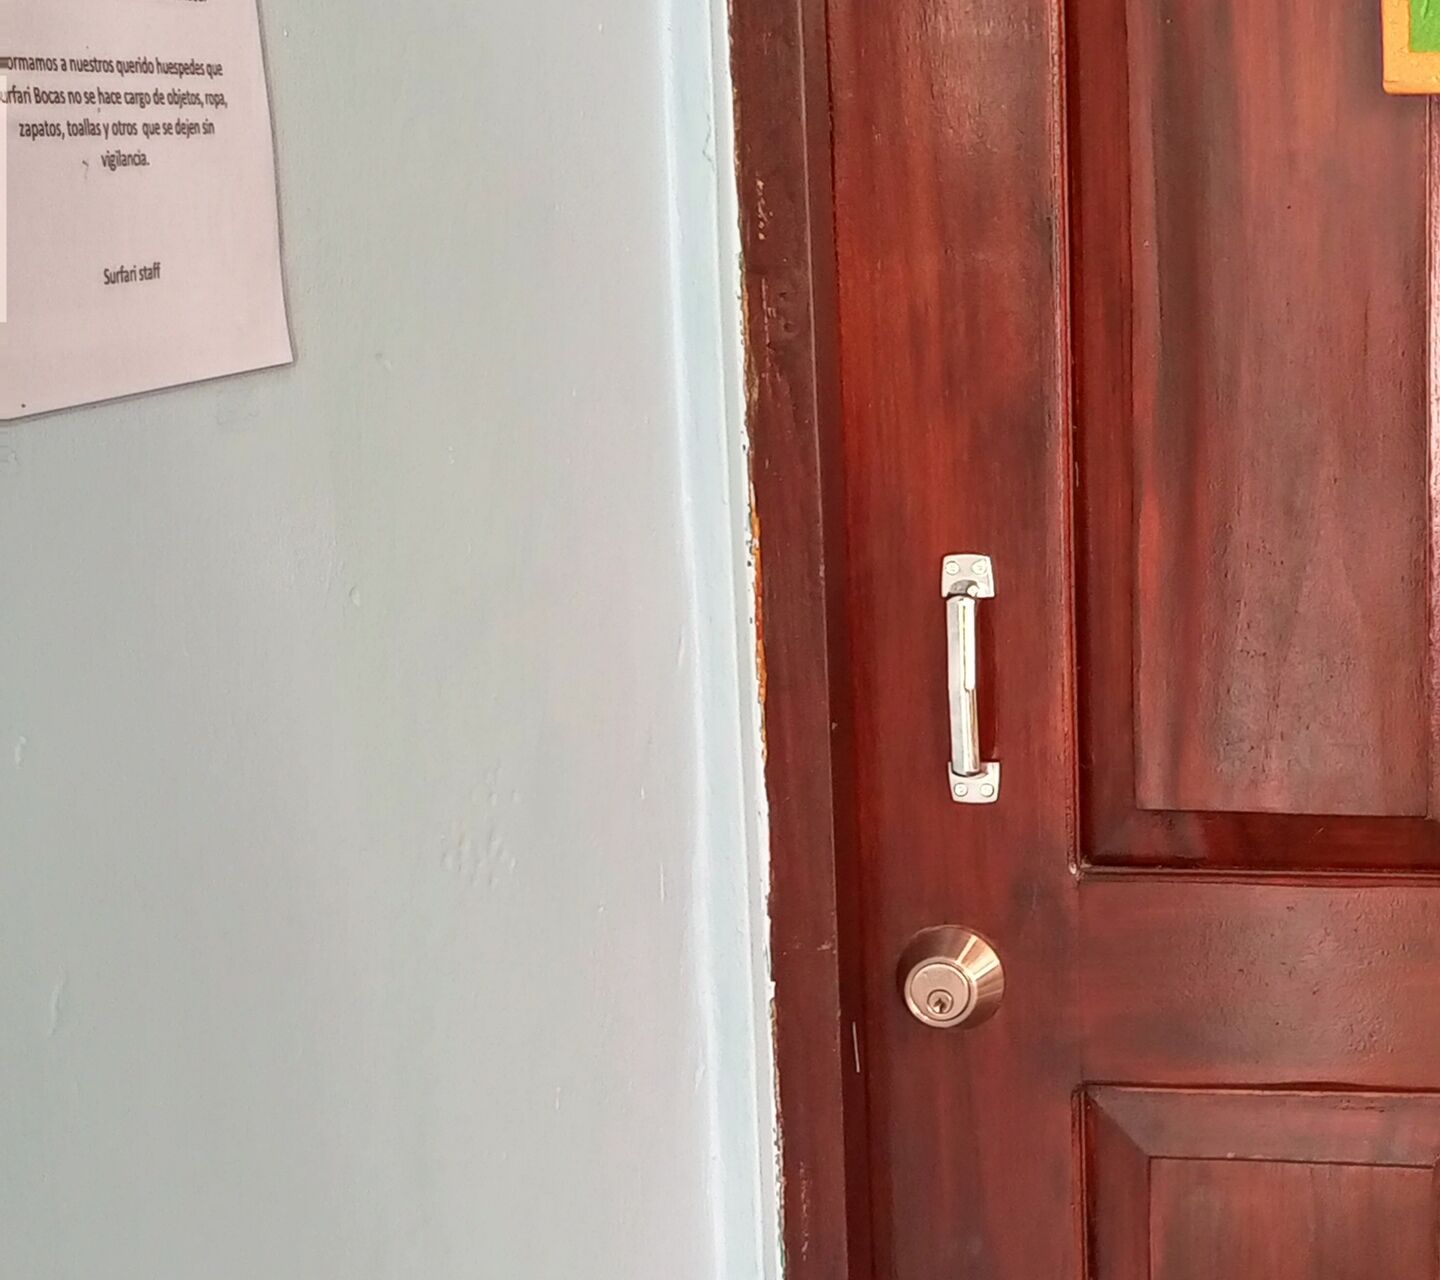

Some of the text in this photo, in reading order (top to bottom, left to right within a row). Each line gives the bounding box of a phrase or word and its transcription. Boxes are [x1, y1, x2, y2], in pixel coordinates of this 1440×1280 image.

[60, 58, 67, 72] a
[69, 57, 114, 73] nuestros
[116, 56, 154, 77] querido
[156, 57, 205, 79] huespedes
[206, 63, 223, 79] que
[33, 87, 65, 105] Bocas
[67, 91, 82, 104] no
[83, 91, 96, 104] se
[97, 86, 122, 104] hace
[123, 91, 151, 109] cargo
[152, 87, 166, 105] de
[167, 88, 204, 109] objetos,
[204, 93, 228, 109] ropa,
[19, 118, 215, 141] zapatos, toallas y otros que se dejen sin
[101, 149, 150, 171] vigilancia.
[104, 262, 160, 285] Surfari staff
